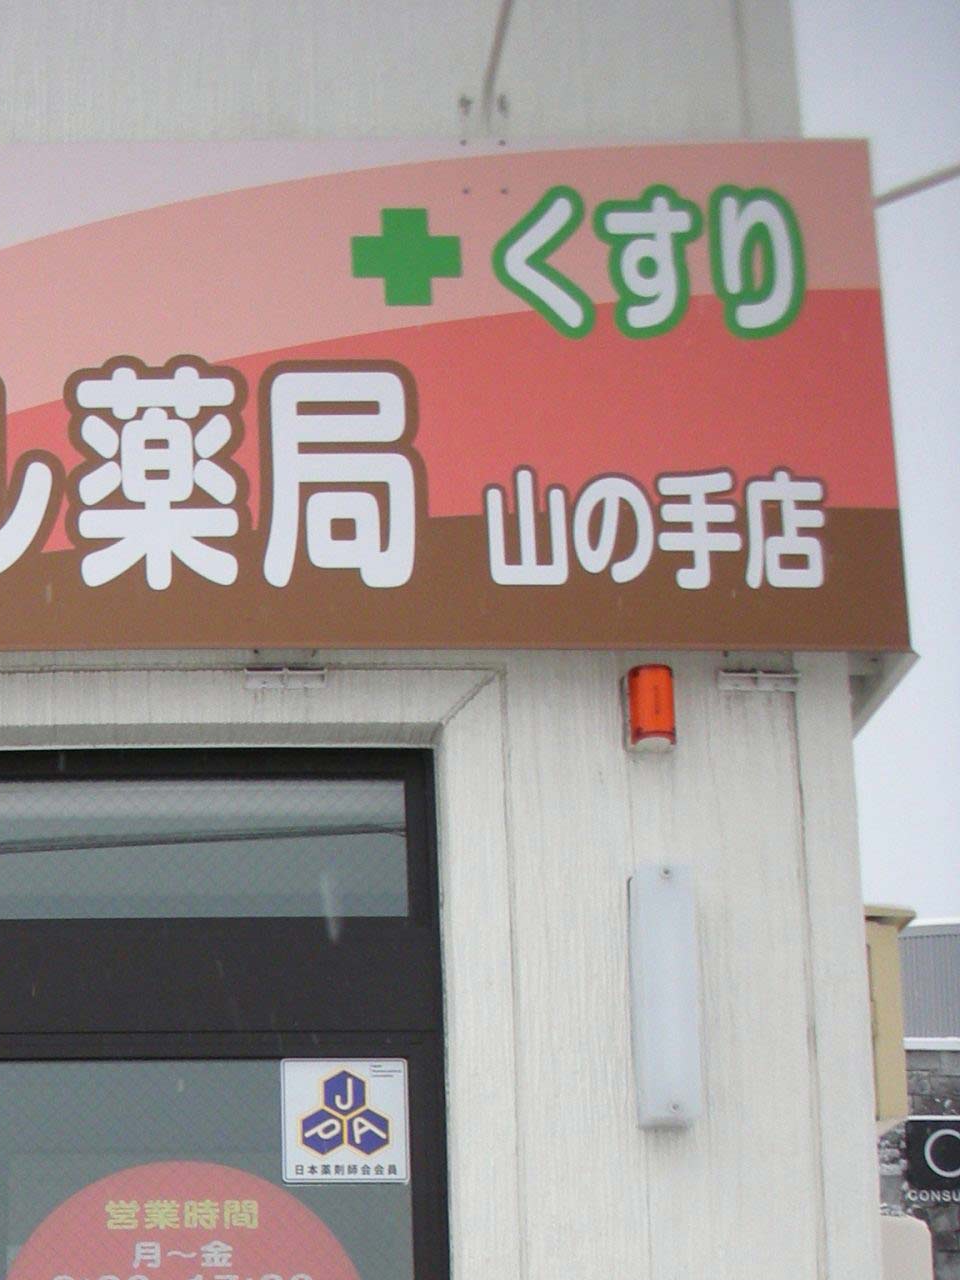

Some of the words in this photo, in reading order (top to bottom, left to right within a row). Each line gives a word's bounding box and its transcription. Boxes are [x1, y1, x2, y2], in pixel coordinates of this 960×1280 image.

[498, 185, 803, 337] くすり
[484, 464, 828, 592] 山の手店
[295, 1164, 398, 1176] 日本薬剤師会会員
[104, 1199, 259, 1230] 営業時間
